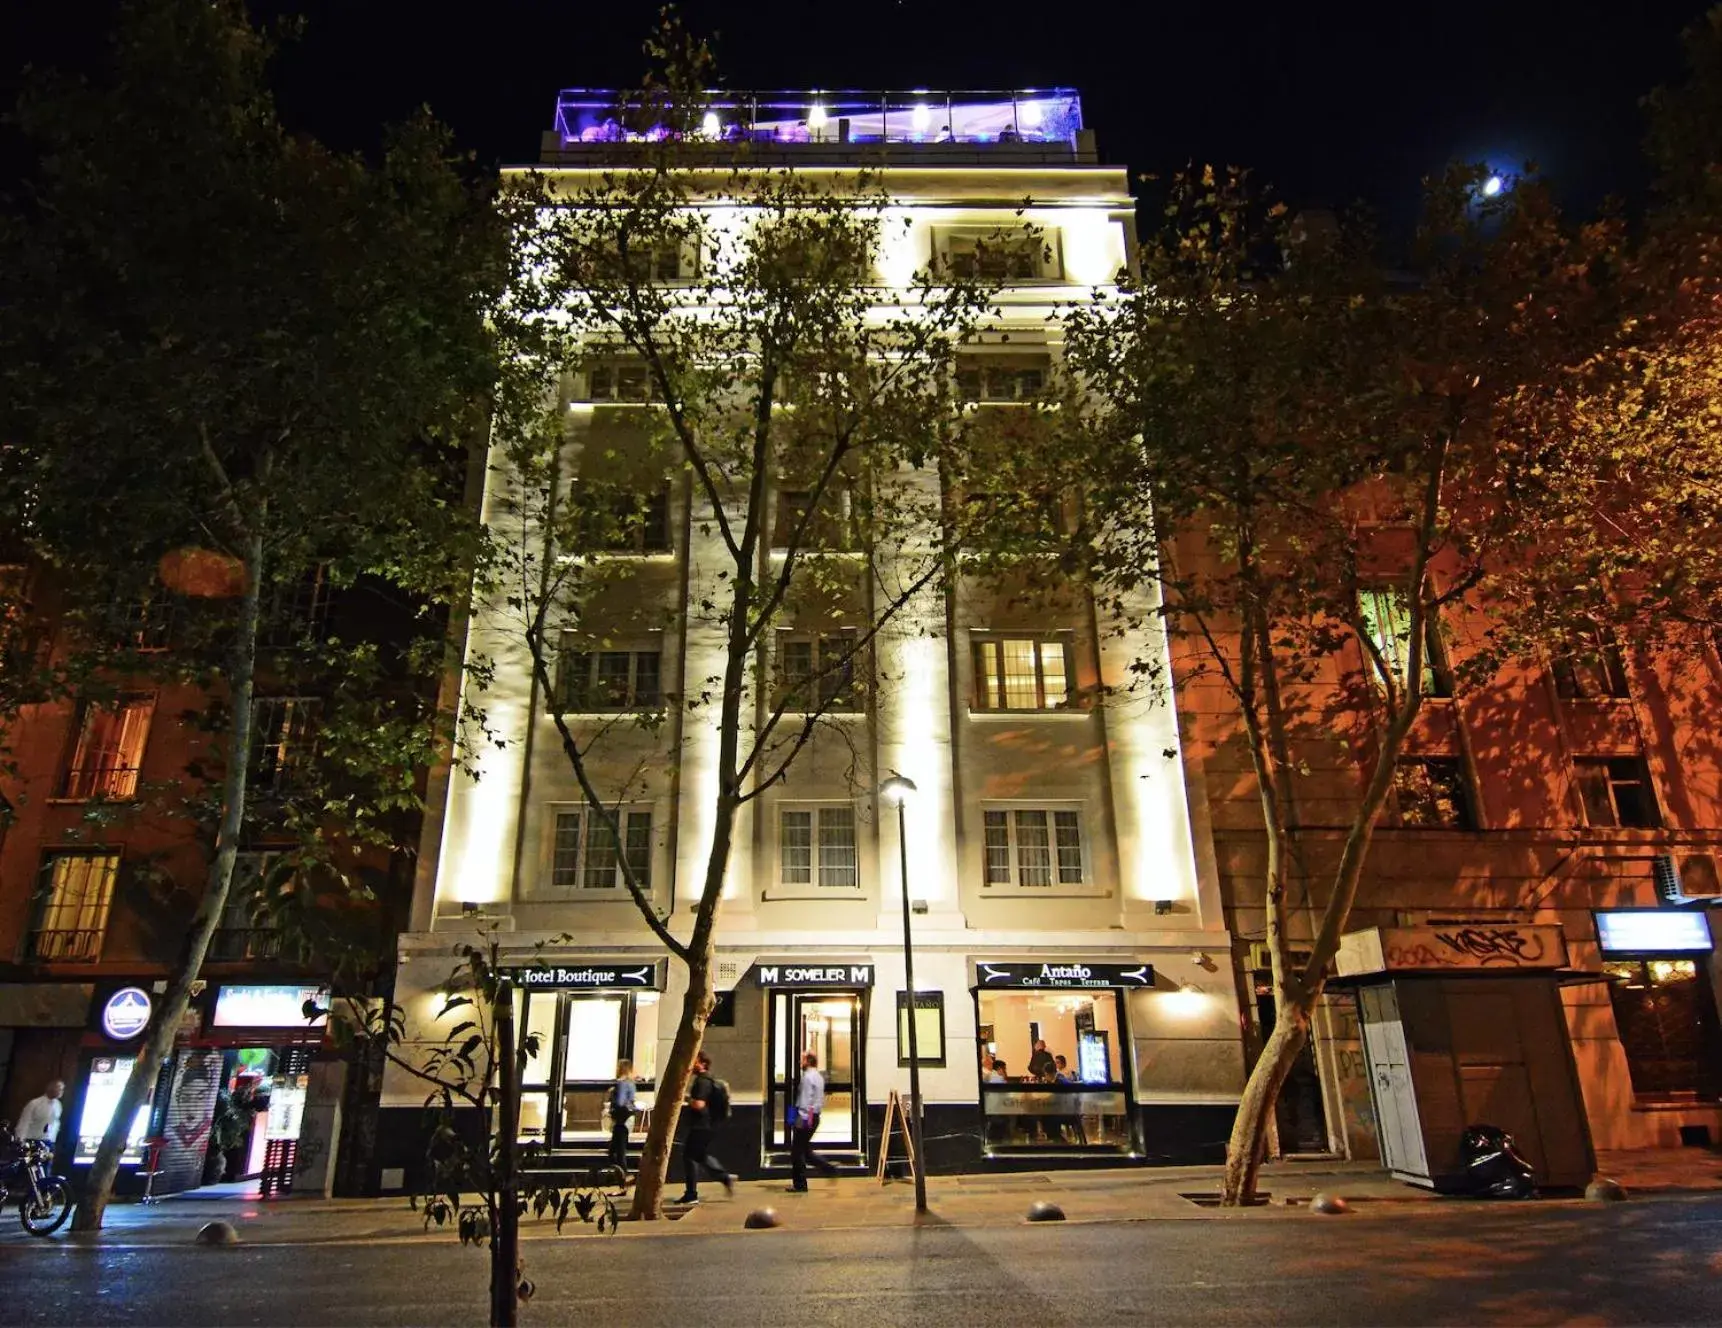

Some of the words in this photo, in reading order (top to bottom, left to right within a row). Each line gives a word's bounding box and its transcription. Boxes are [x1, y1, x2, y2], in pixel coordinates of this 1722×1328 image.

[556, 968, 615, 986] Boutique
[760, 967, 779, 983] M
[784, 968, 846, 981] SOMELIER
[850, 966, 869, 983] M
[1040, 963, 1092, 978] Antaño
